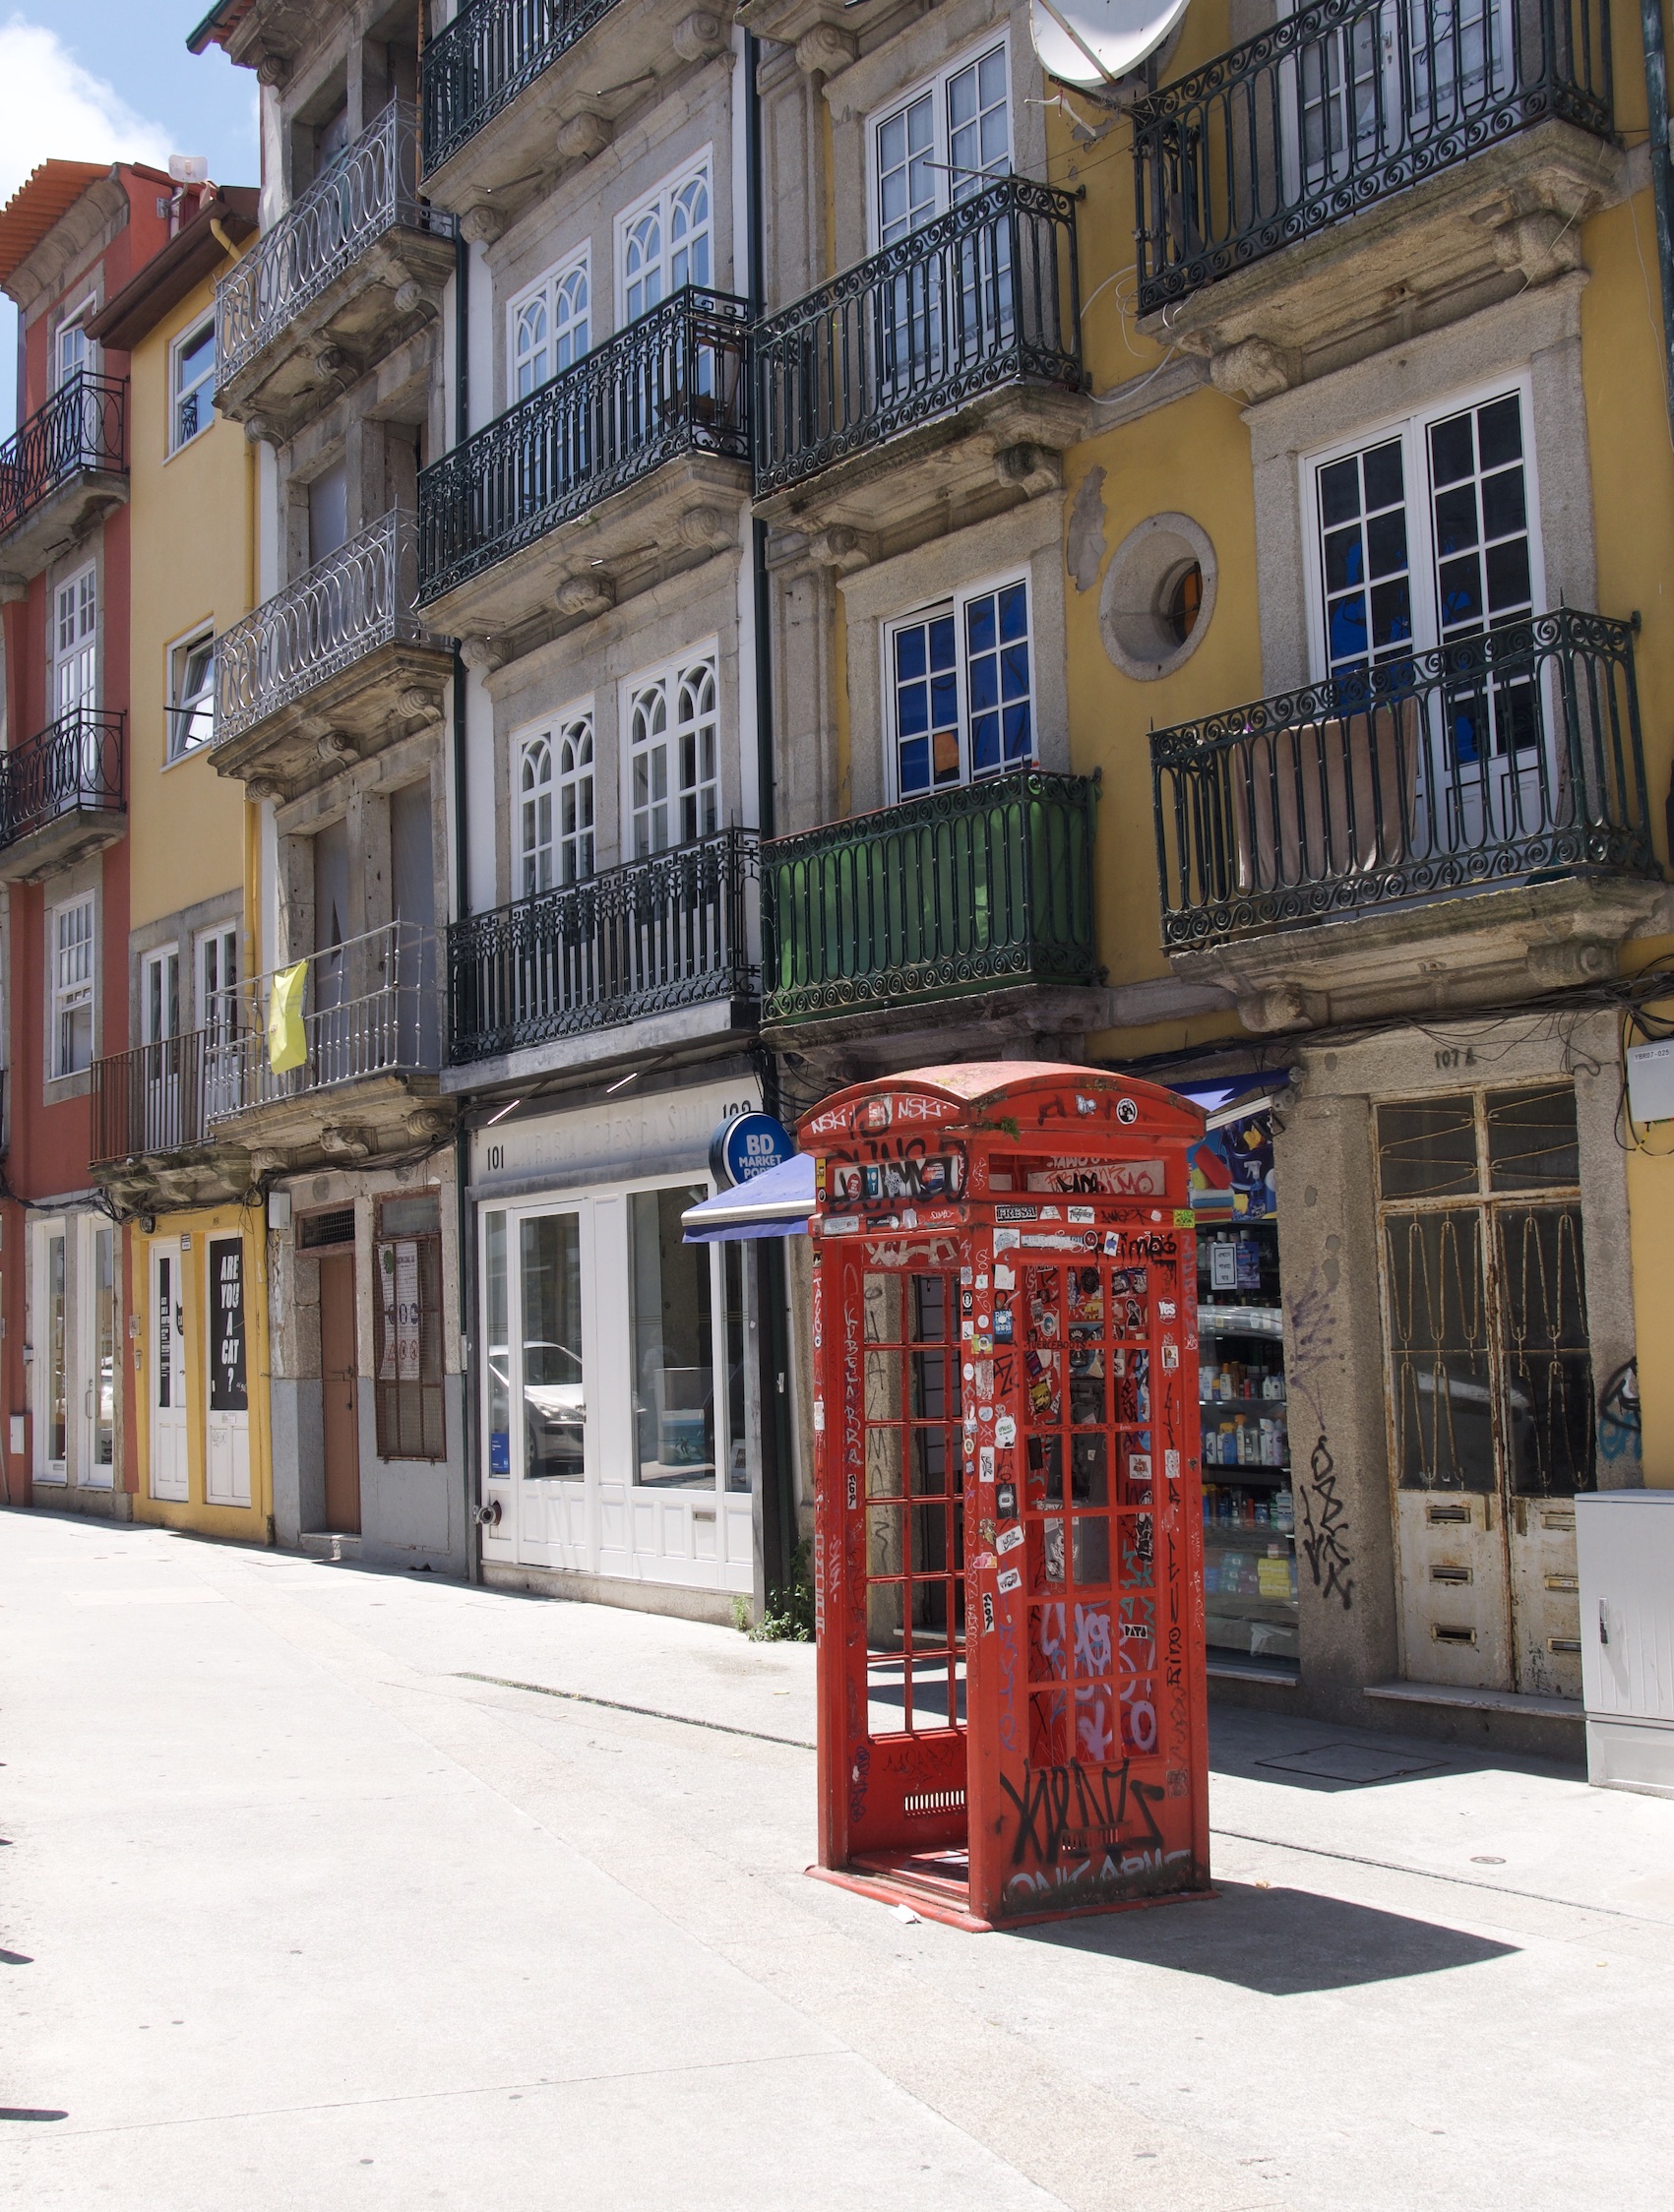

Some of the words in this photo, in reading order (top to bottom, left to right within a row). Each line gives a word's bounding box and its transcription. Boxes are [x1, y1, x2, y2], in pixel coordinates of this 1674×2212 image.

[1434, 1049, 1458, 1069] 107
[1635, 1049, 1670, 1061] YBR07-025
[746, 1134, 775, 1155] BD
[487, 1145, 504, 1171] 101
[739, 1155, 781, 1168] MARKET
[220, 1255, 239, 1281] ARE
[220, 1283, 239, 1309] YOU
[1158, 1301, 1176, 1315] Yes
[226, 1311, 233, 1336] A
[220, 1339, 240, 1365] CAT
[227, 1367, 234, 1392] ?
